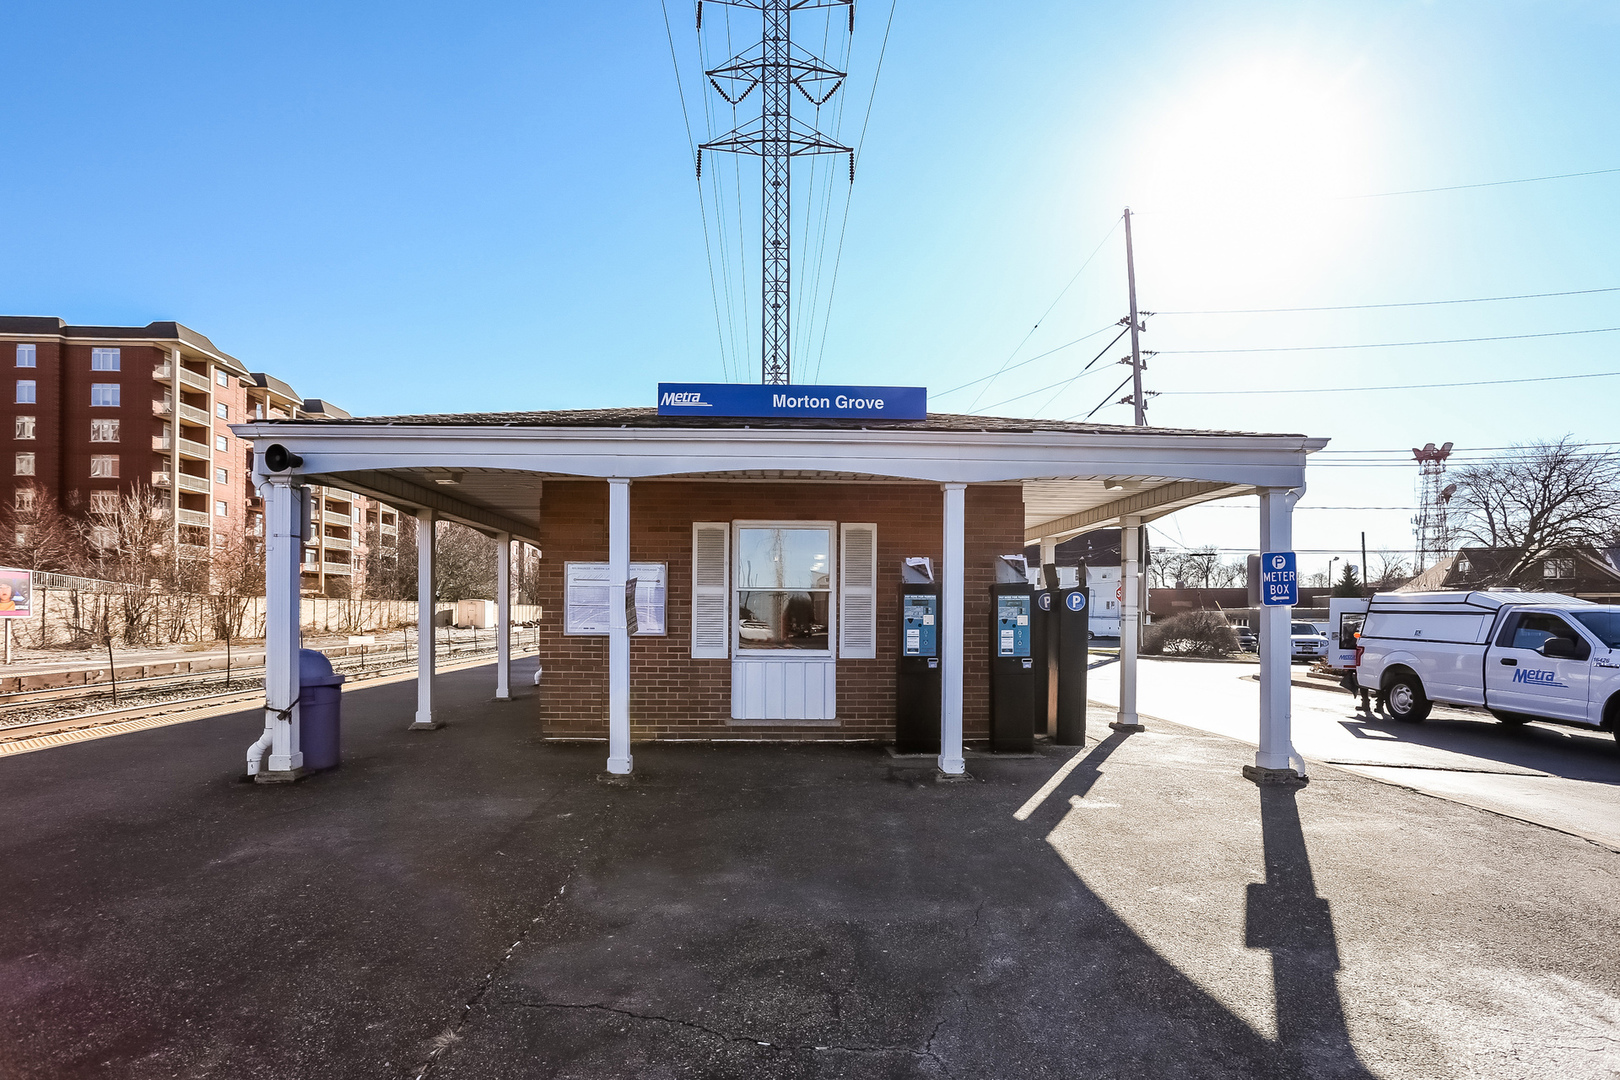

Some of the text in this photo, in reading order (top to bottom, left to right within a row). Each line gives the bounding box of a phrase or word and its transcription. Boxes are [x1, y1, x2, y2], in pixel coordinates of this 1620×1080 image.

[660, 391, 701, 406] Metra
[772, 394, 885, 410] Morton Grove
[1275, 557, 1283, 568] P
[1263, 571, 1295, 582] METER
[1270, 584, 1290, 595] BOX
[1072, 595, 1081, 608] P
[1512, 668, 1555, 682] Metra
